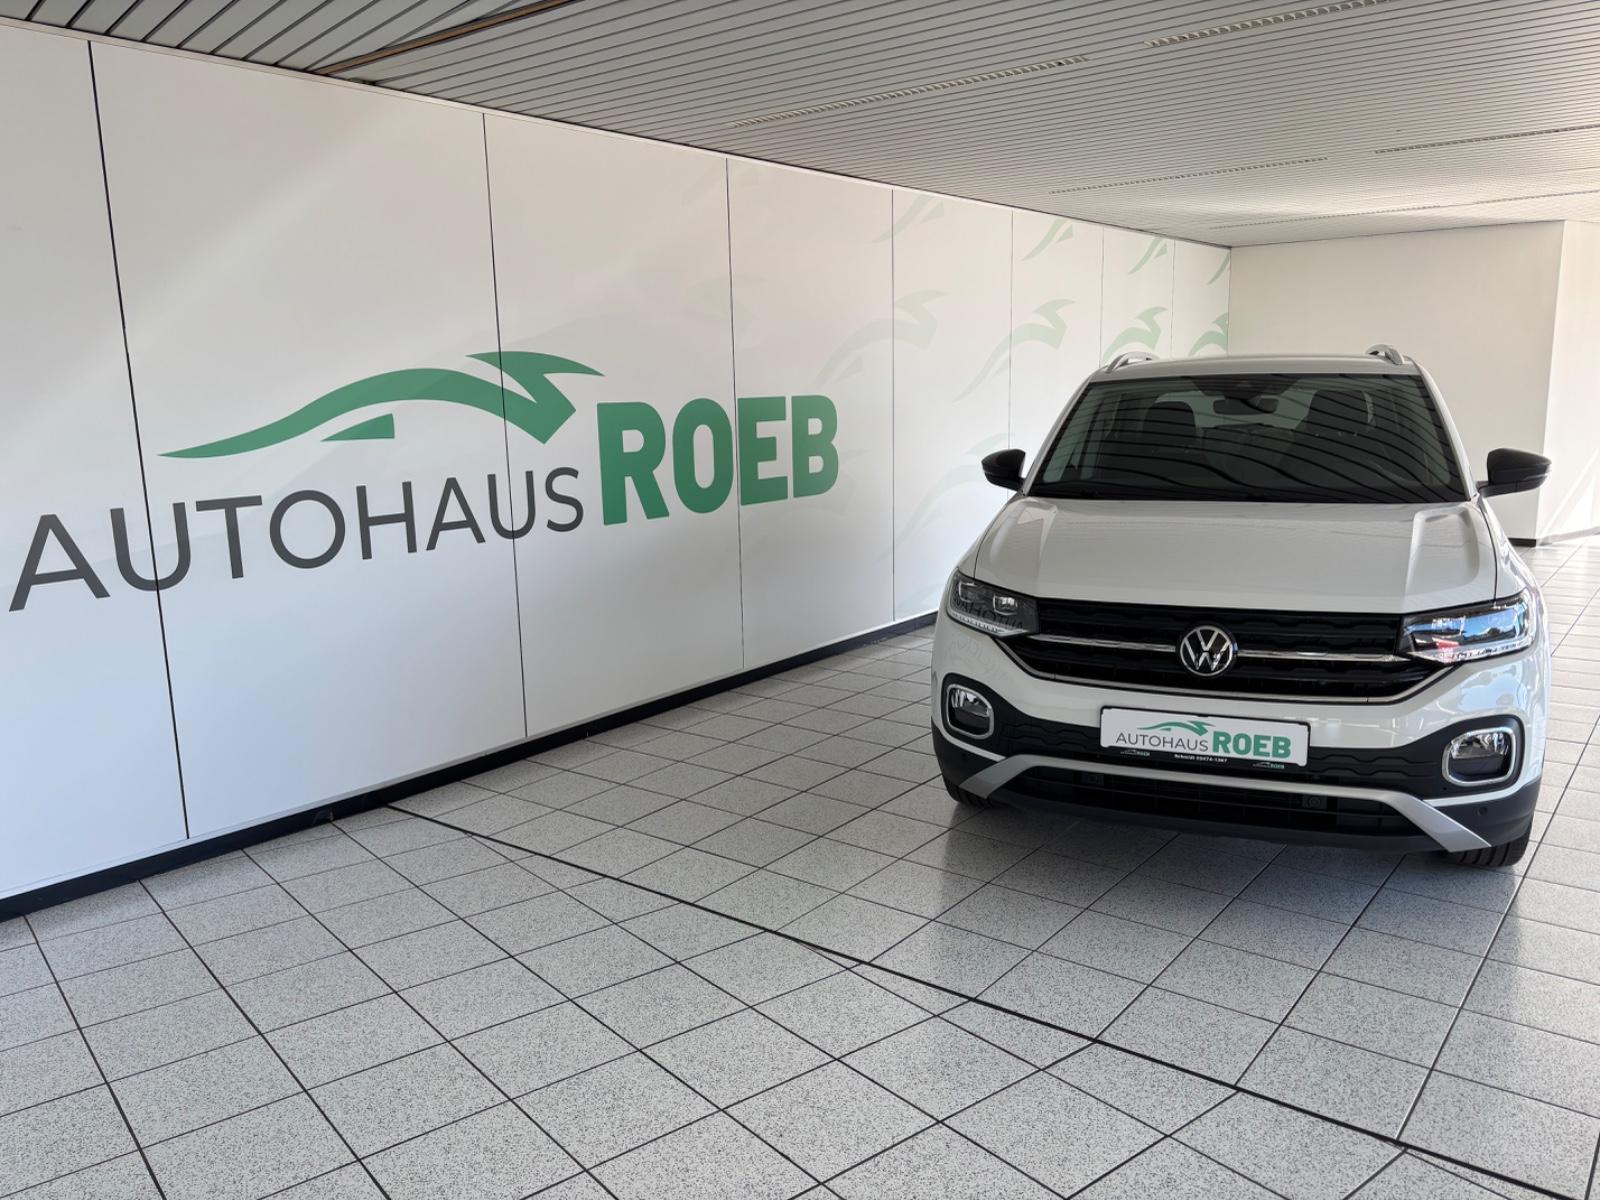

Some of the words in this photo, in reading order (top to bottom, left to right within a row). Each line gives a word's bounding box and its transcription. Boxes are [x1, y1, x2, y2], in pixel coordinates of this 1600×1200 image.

[9, 466, 585, 612] AUTOHAUS
[597, 394, 839, 526] ROEB
[1115, 732, 1209, 753] AUTOHAUS
[1212, 730, 1292, 759] ROEB
